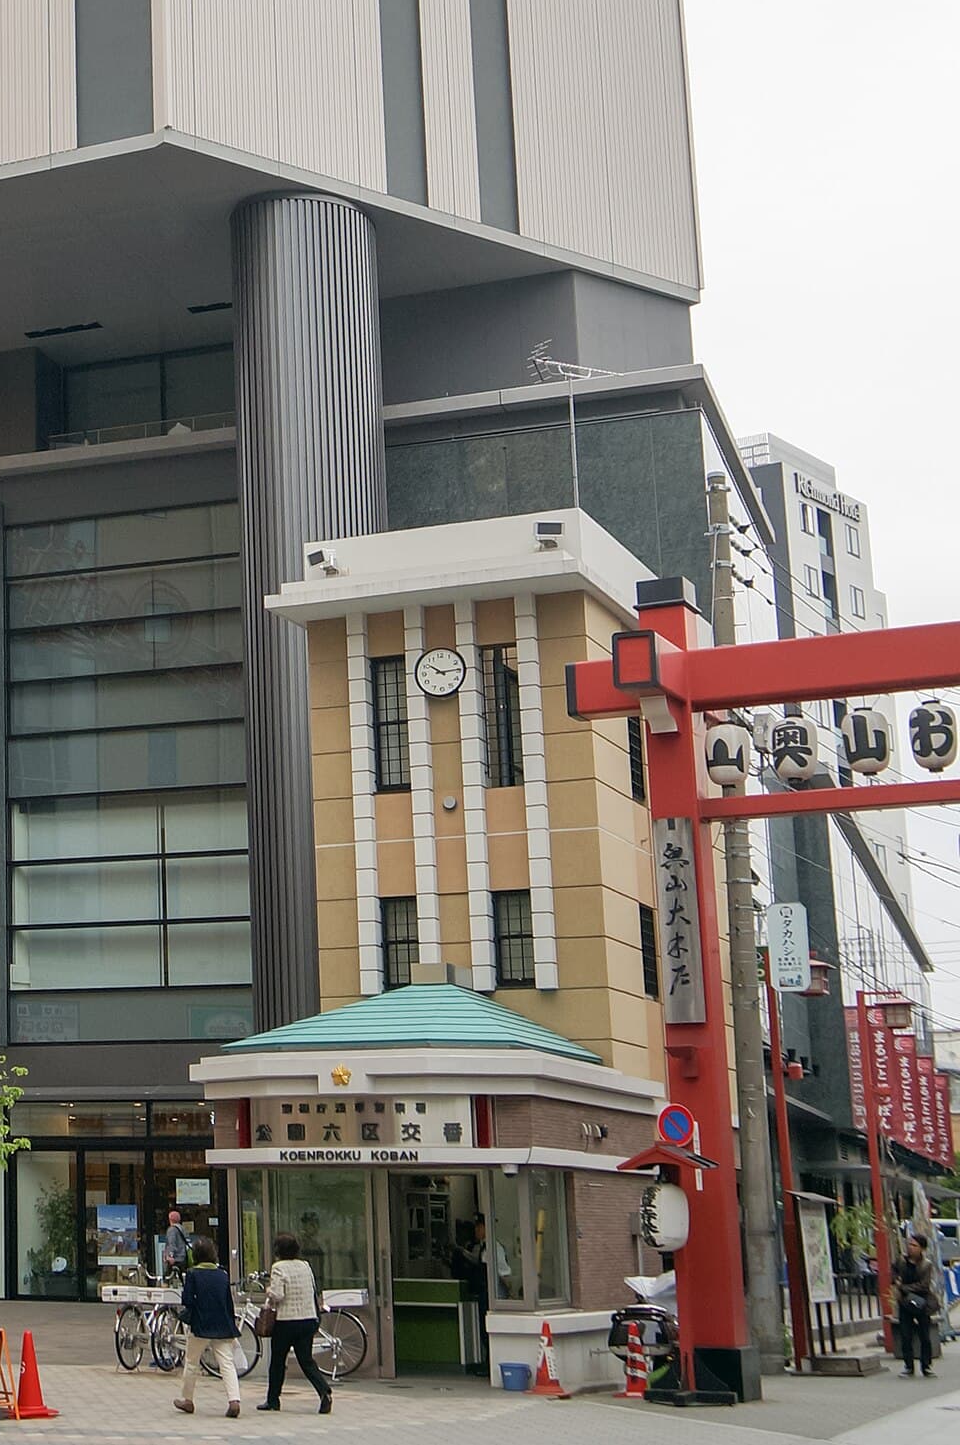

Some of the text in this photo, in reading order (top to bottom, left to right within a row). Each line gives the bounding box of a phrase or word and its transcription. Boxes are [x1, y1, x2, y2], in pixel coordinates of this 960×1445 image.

[783, 919, 796, 956] タカハシ
[255, 1122, 463, 1143] 公園六区交番
[279, 1150, 419, 1161] KOENROKKU KOBAN
